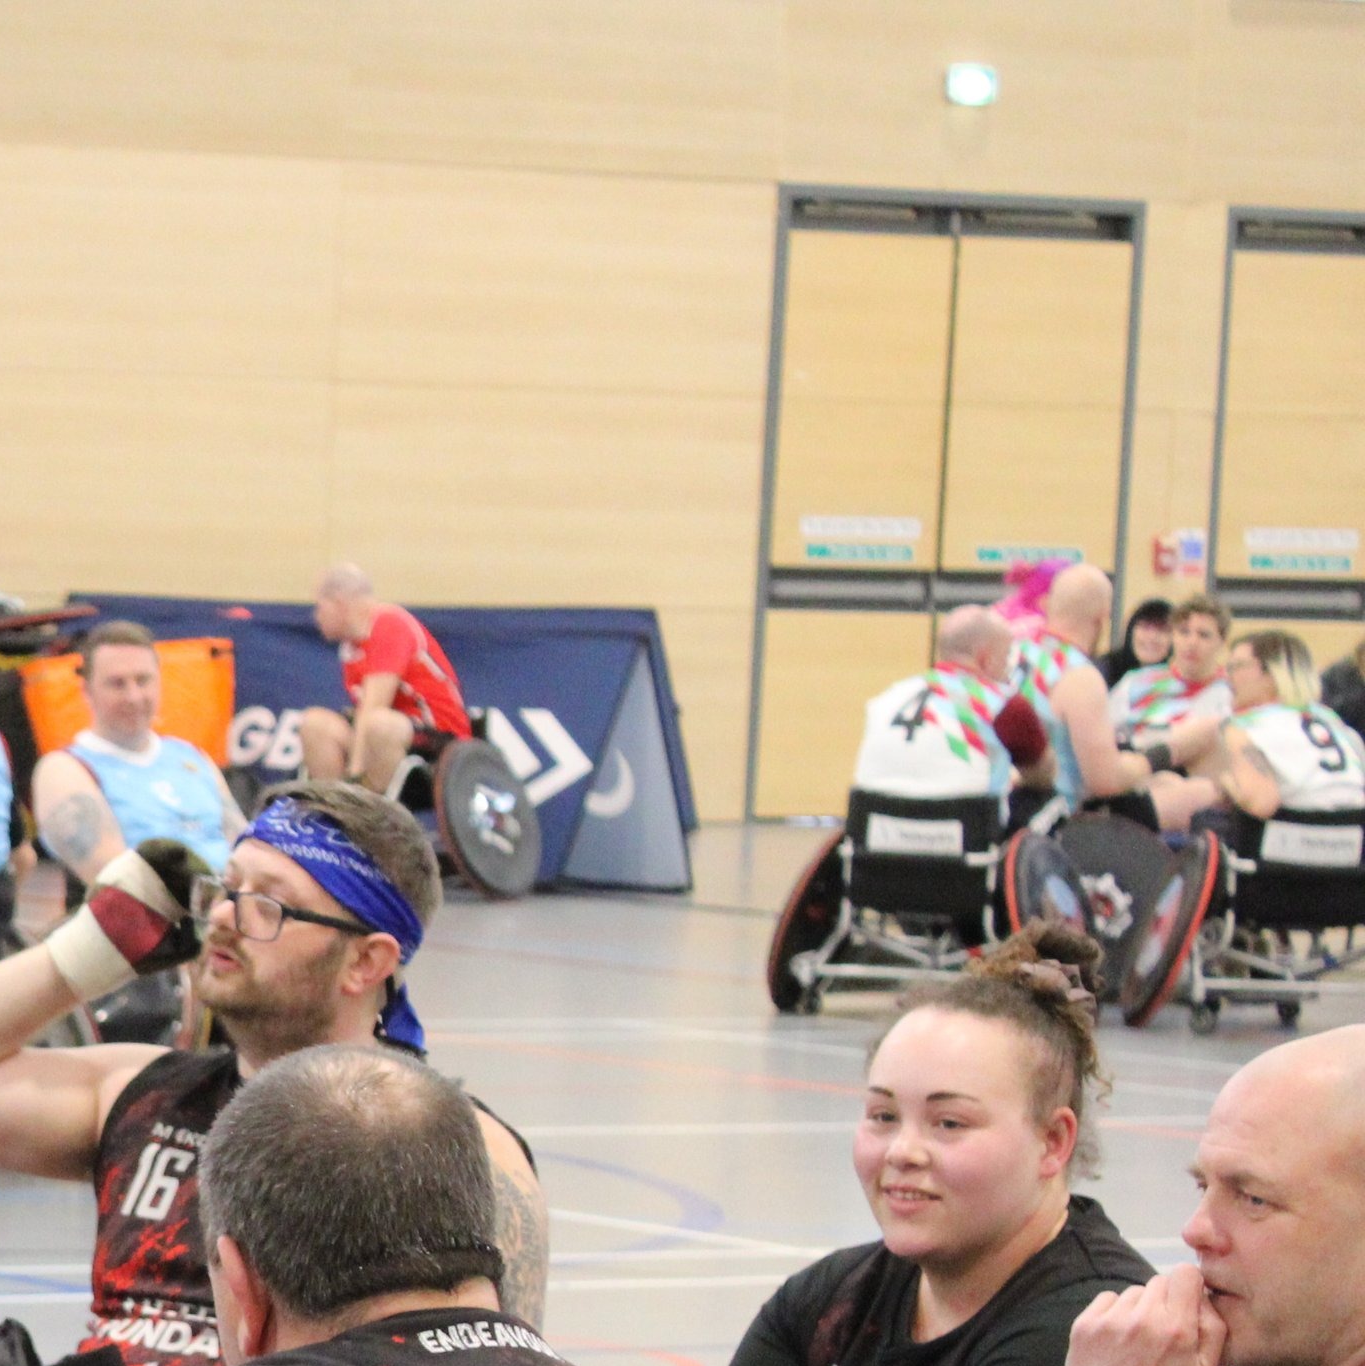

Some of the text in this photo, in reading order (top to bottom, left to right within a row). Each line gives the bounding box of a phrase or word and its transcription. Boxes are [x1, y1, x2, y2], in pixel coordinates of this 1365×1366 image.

[890, 688, 932, 742] 4
[1299, 711, 1348, 773] 9
[121, 1142, 195, 1221] 16
